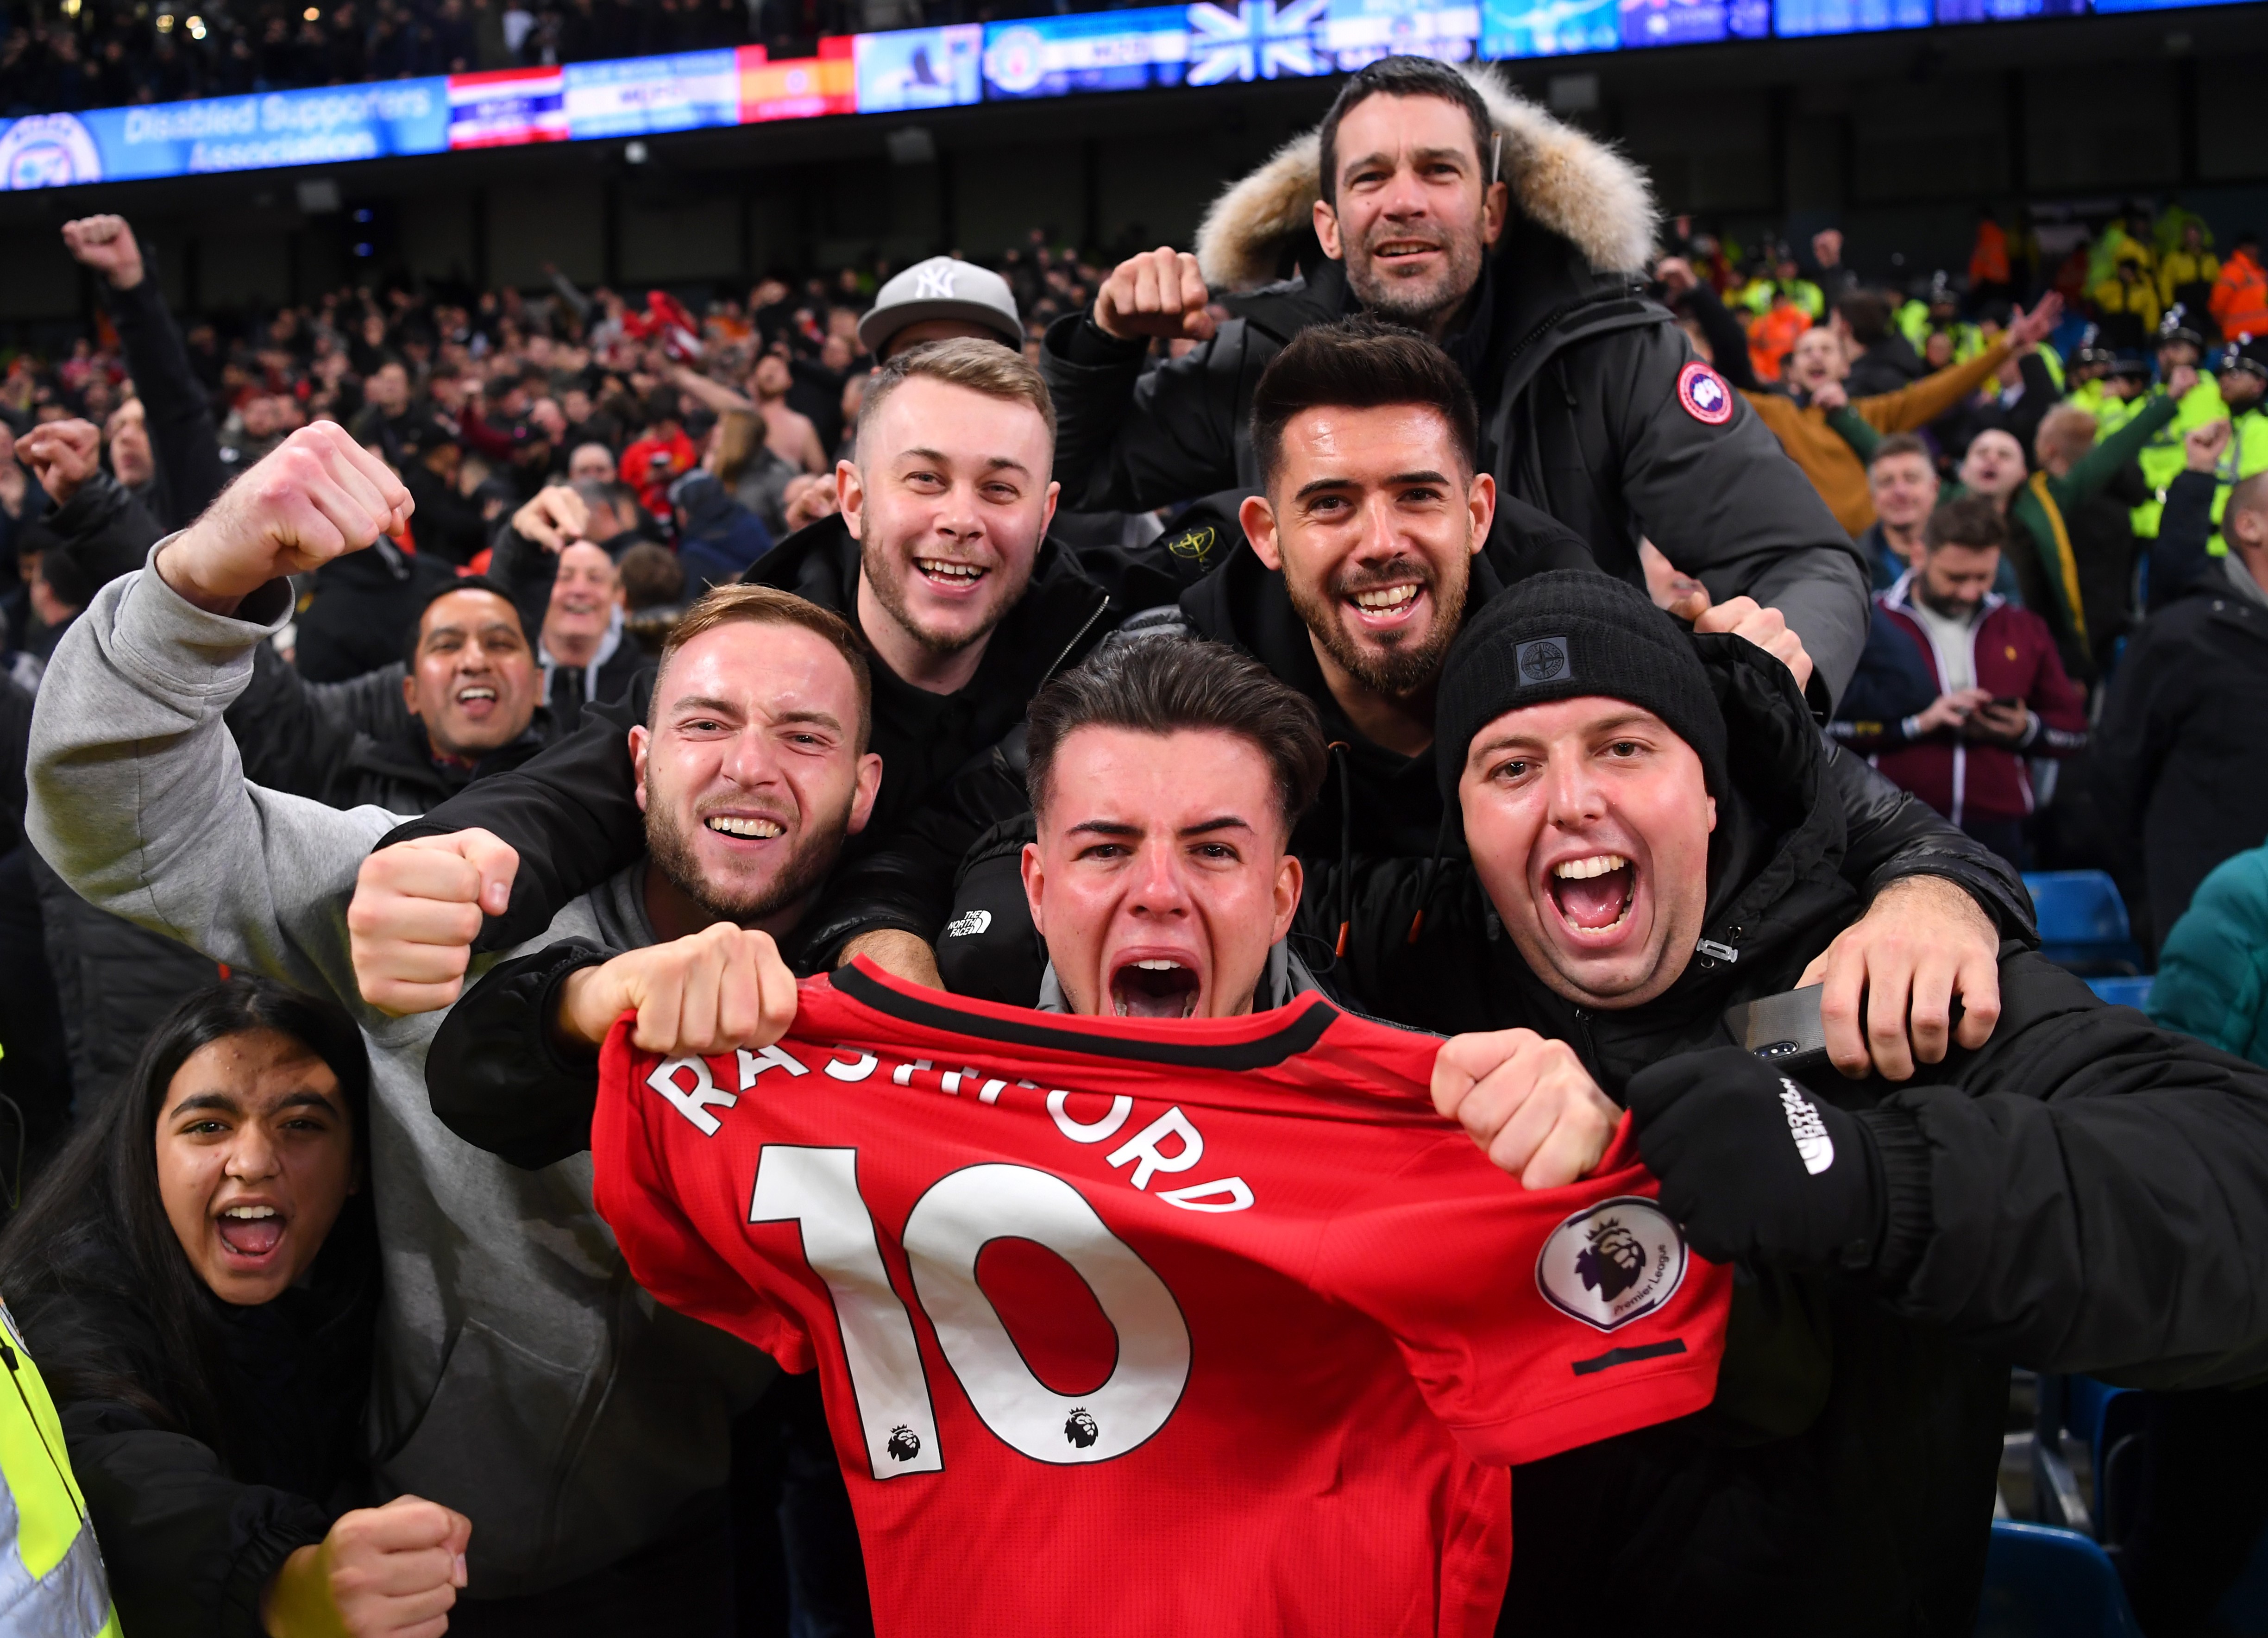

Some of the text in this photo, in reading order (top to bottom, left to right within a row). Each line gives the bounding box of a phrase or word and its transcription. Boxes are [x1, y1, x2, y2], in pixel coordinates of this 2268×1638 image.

[124, 97, 258, 144] Disabled
[188, 132, 377, 173] Association
[916, 265, 955, 299] NY
[947, 918, 977, 930] NORTH
[949, 926, 970, 937] FACE
[964, 910, 982, 920] THE
[1779, 1077, 1817, 1137] NORTH
[1779, 1092, 1804, 1140] FACE
[1807, 1102, 1828, 1136] THE
[1614, 1243, 1670, 1316] Premier League
[748, 1143, 1194, 1481] 10
